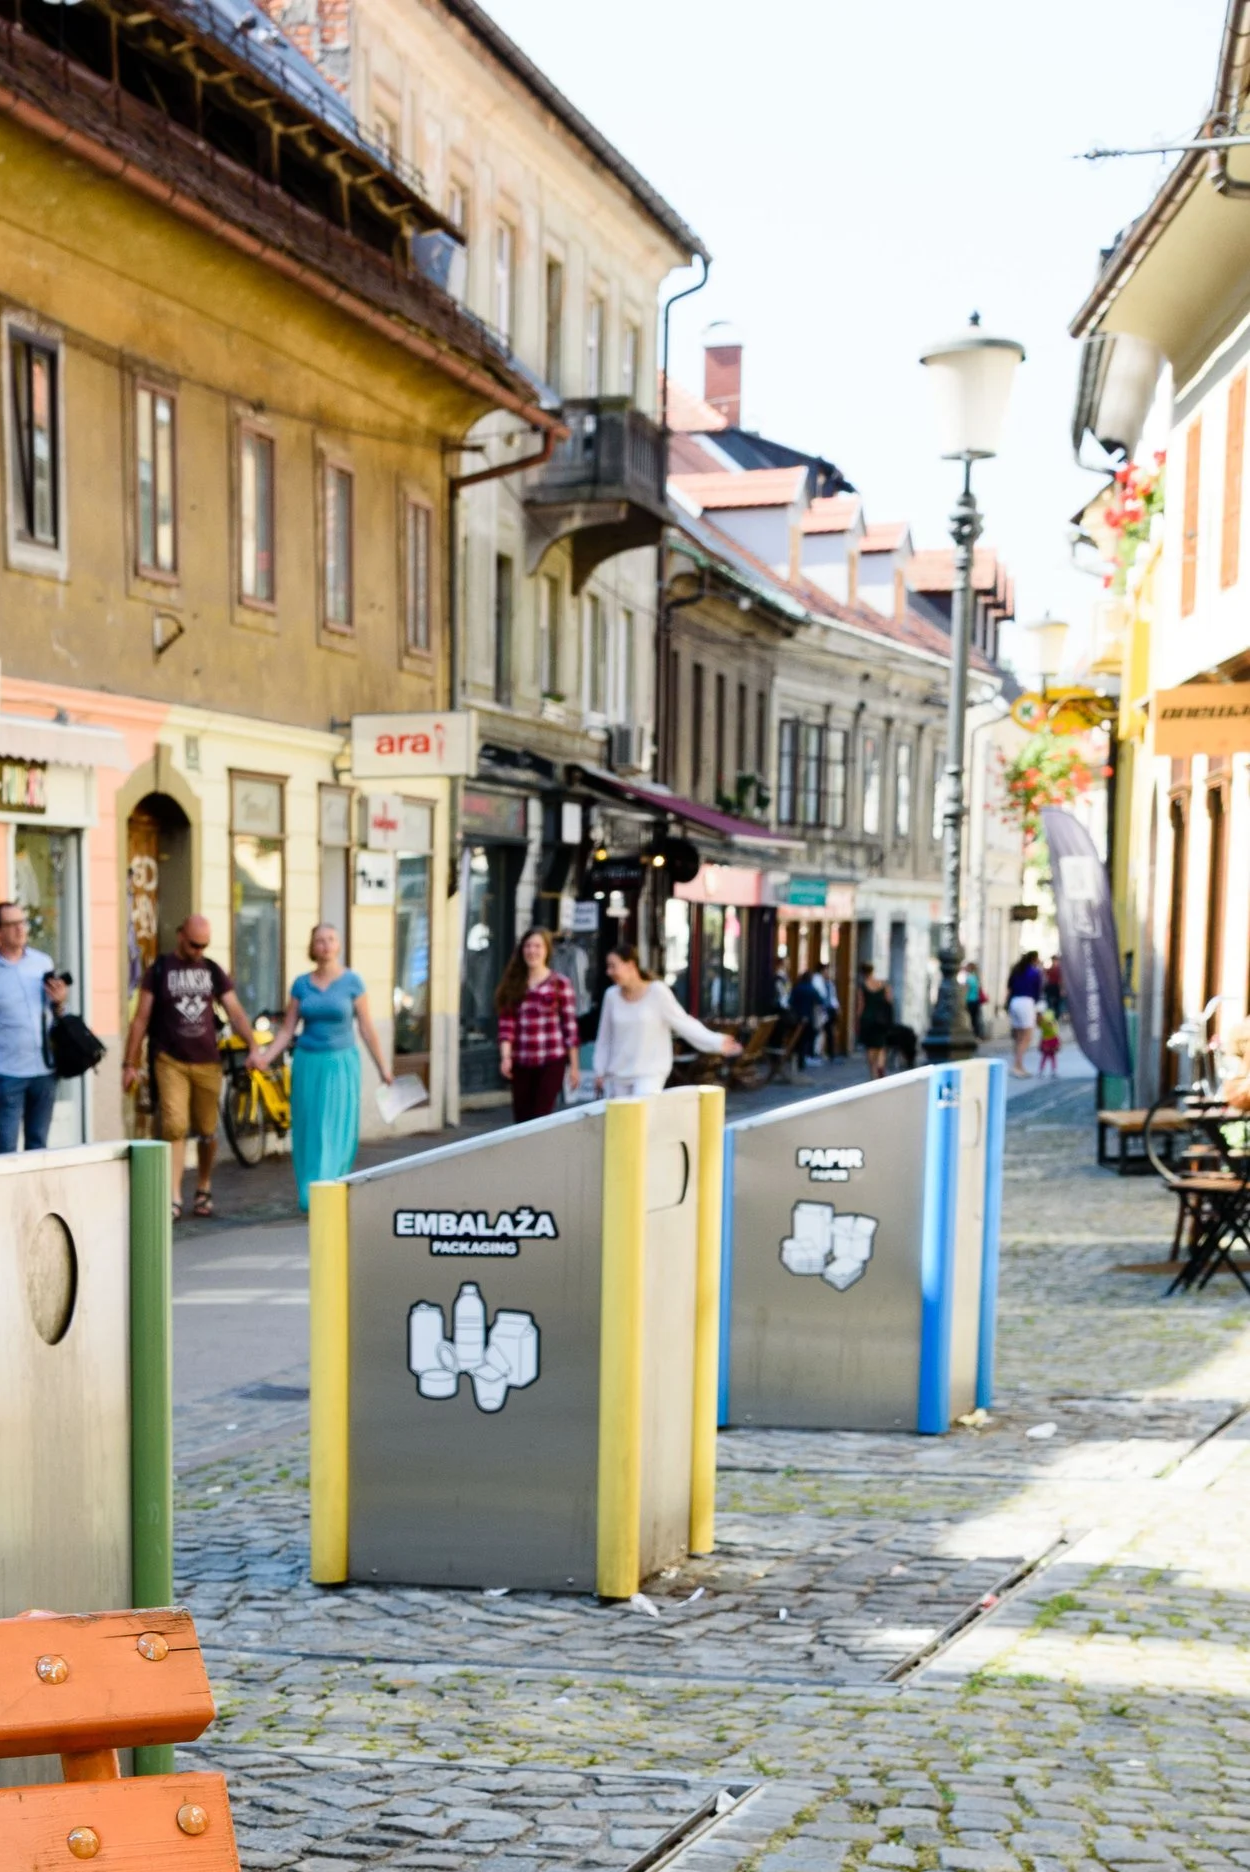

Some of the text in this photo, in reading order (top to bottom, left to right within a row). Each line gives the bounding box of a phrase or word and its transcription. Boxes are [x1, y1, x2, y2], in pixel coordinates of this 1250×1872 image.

[375, 733, 431, 756] ara
[798, 1148, 864, 1169] PAPIR
[396, 1209, 557, 1238] EMBALAŽA
[431, 1240, 518, 1256] PACKAGING
